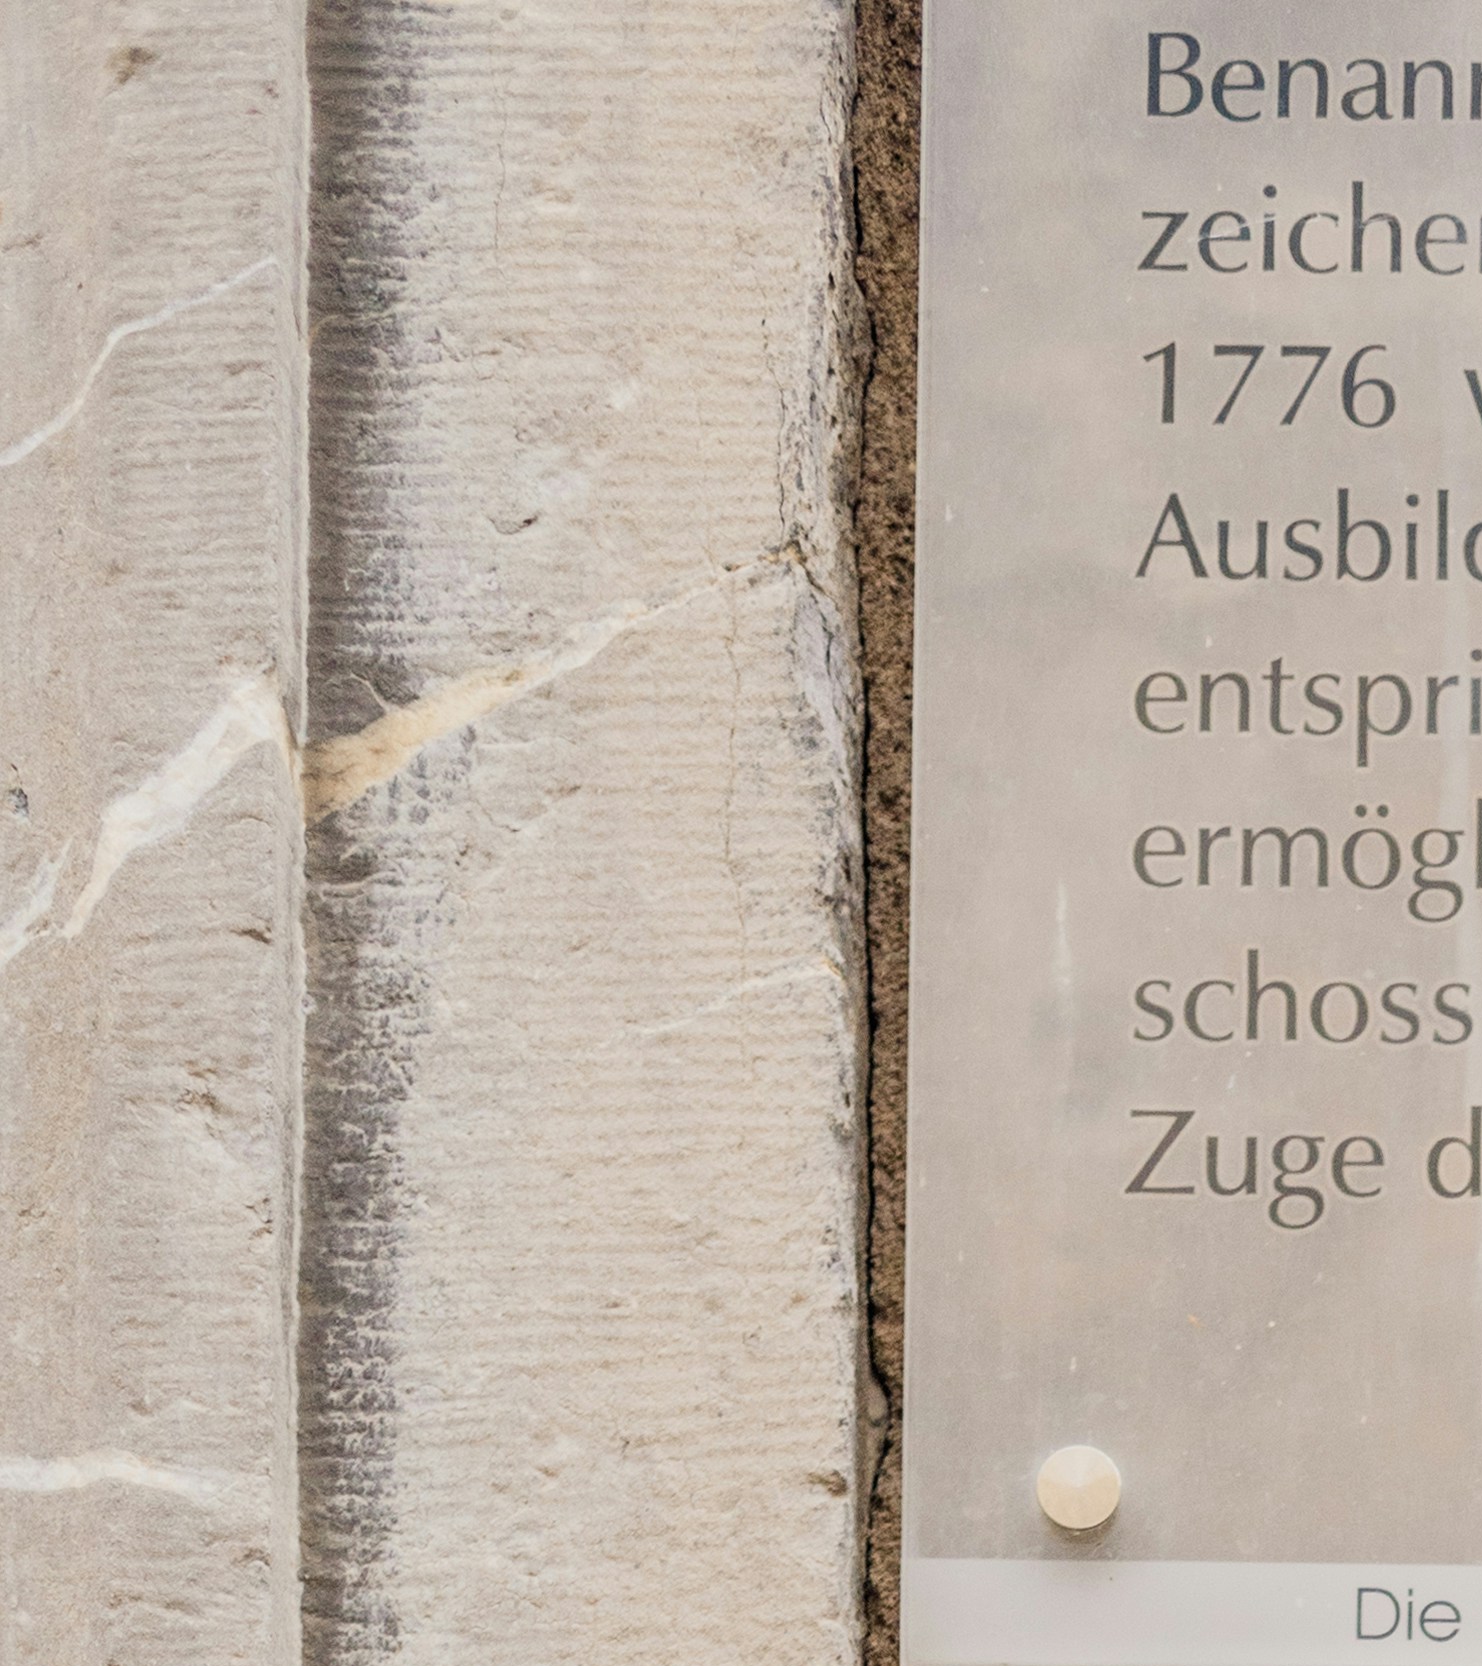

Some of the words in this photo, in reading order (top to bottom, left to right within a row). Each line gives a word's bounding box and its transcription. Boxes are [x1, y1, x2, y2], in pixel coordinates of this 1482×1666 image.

[1141, 339, 1398, 430] 1776
[1123, 1108, 1386, 1231] Zuge
[1355, 1586, 1463, 1643] Die
